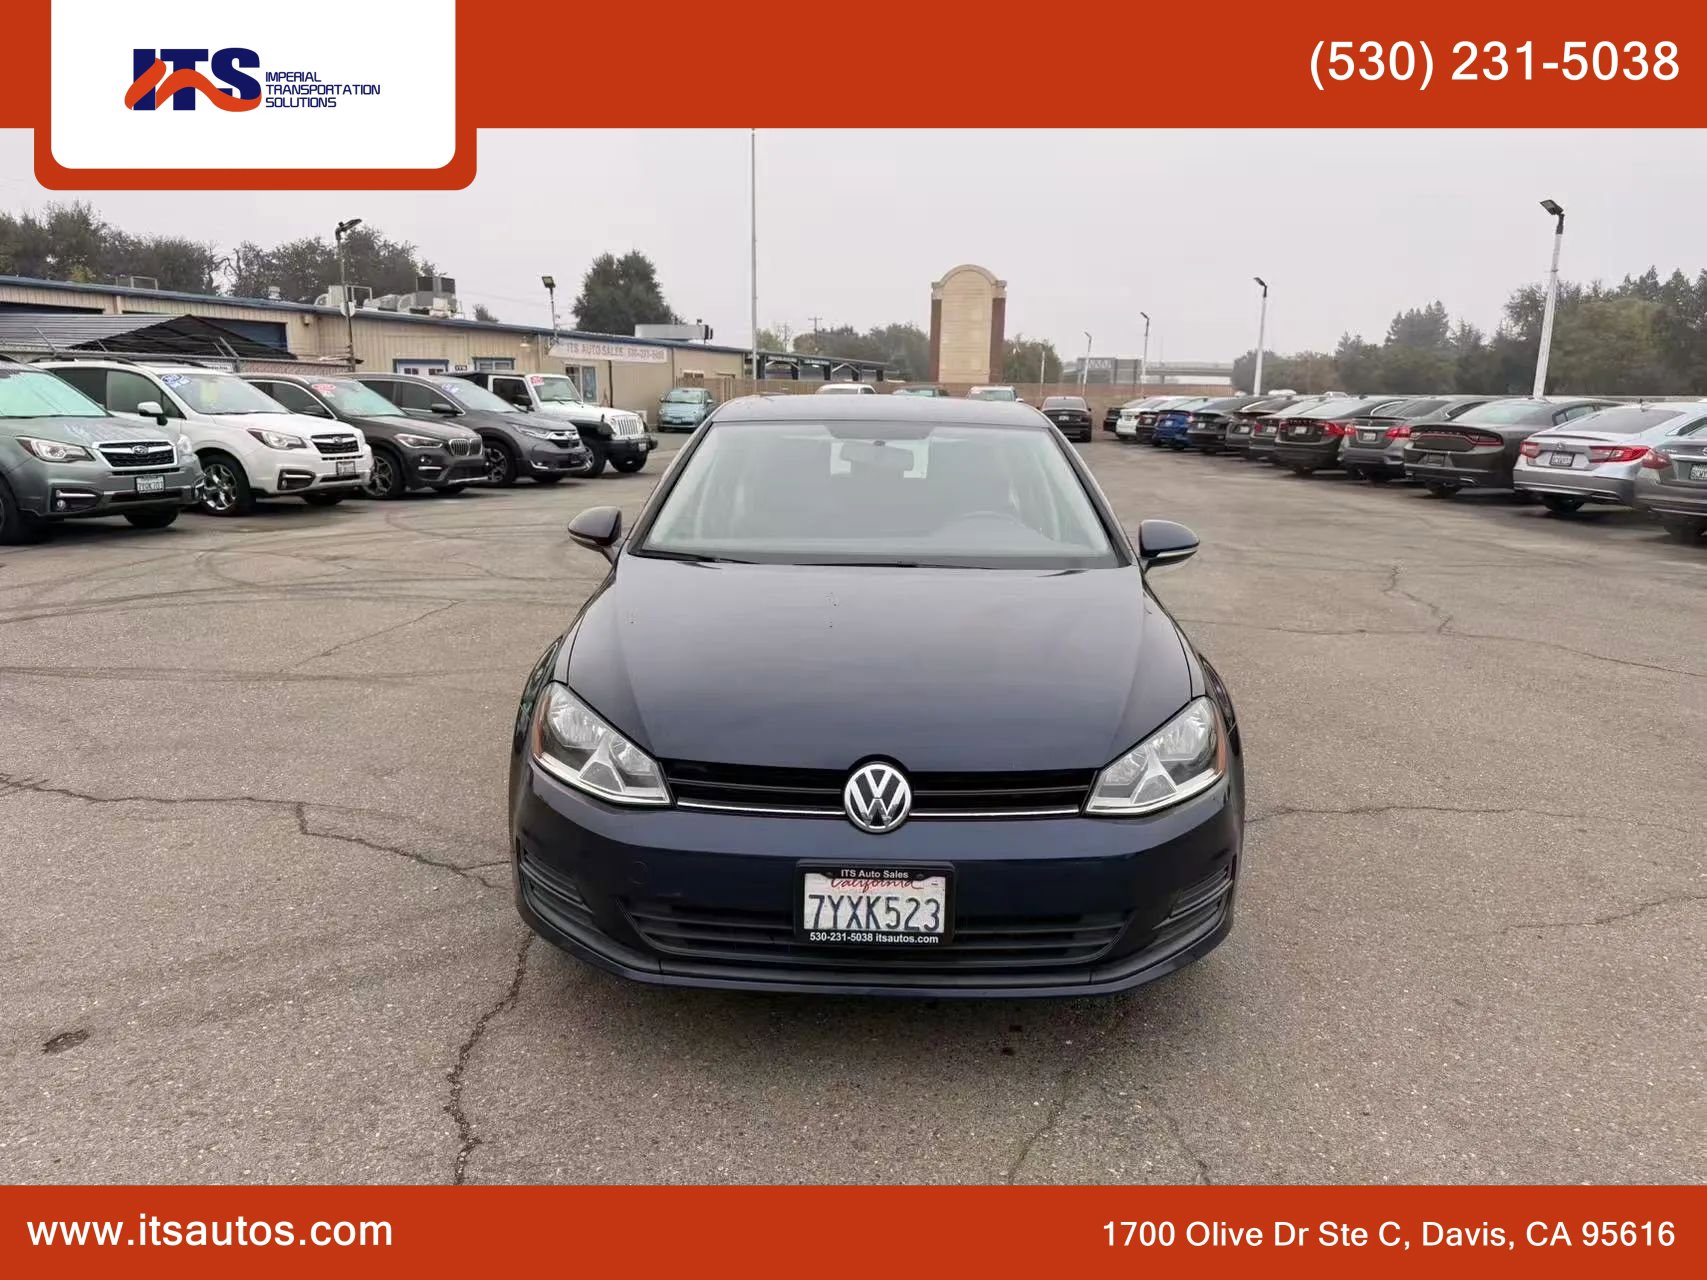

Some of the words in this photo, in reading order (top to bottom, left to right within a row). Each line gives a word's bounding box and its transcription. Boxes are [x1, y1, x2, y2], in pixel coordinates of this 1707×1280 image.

[840, 869, 857, 878] ITS
[858, 869, 881, 879] Auto
[883, 870, 909, 879] Sales
[808, 894, 941, 932] 7YXK523
[809, 932, 874, 942] 530-231-5038
[875, 932, 939, 944] itsautos.com
